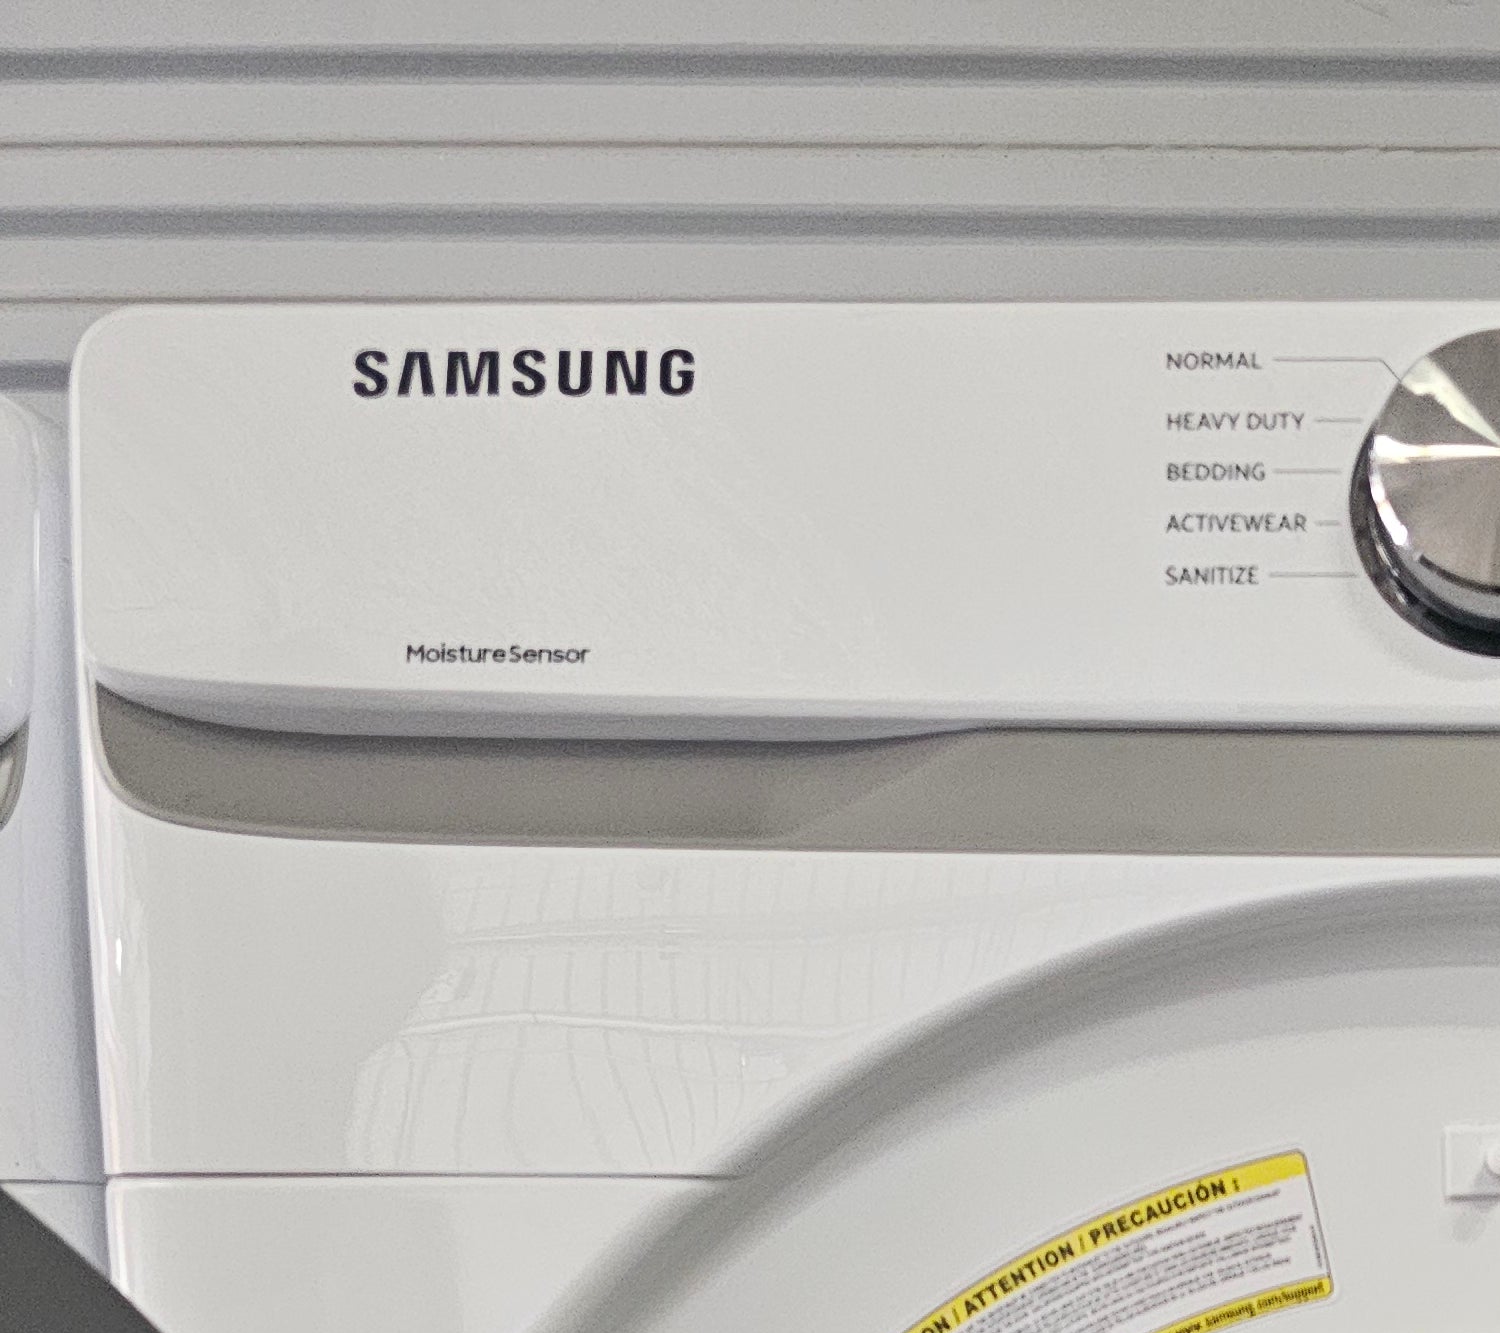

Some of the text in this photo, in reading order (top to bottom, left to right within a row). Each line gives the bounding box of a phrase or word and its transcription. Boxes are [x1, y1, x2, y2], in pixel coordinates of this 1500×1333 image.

[1166, 351, 1260, 371] NORMAL
[353, 348, 695, 399] SAMSUNG
[1167, 411, 1305, 431] HEAVY DUTY
[1166, 462, 1266, 482] BEDDING
[1166, 512, 1307, 533] ACTIVEWEAR
[1165, 566, 1257, 585] SANITIZE
[406, 643, 590, 664] Moisture Sensor
[964, 1243, 1075, 1317] ATTENTION
[1089, 1178, 1226, 1245] PRECAUCIÓN
